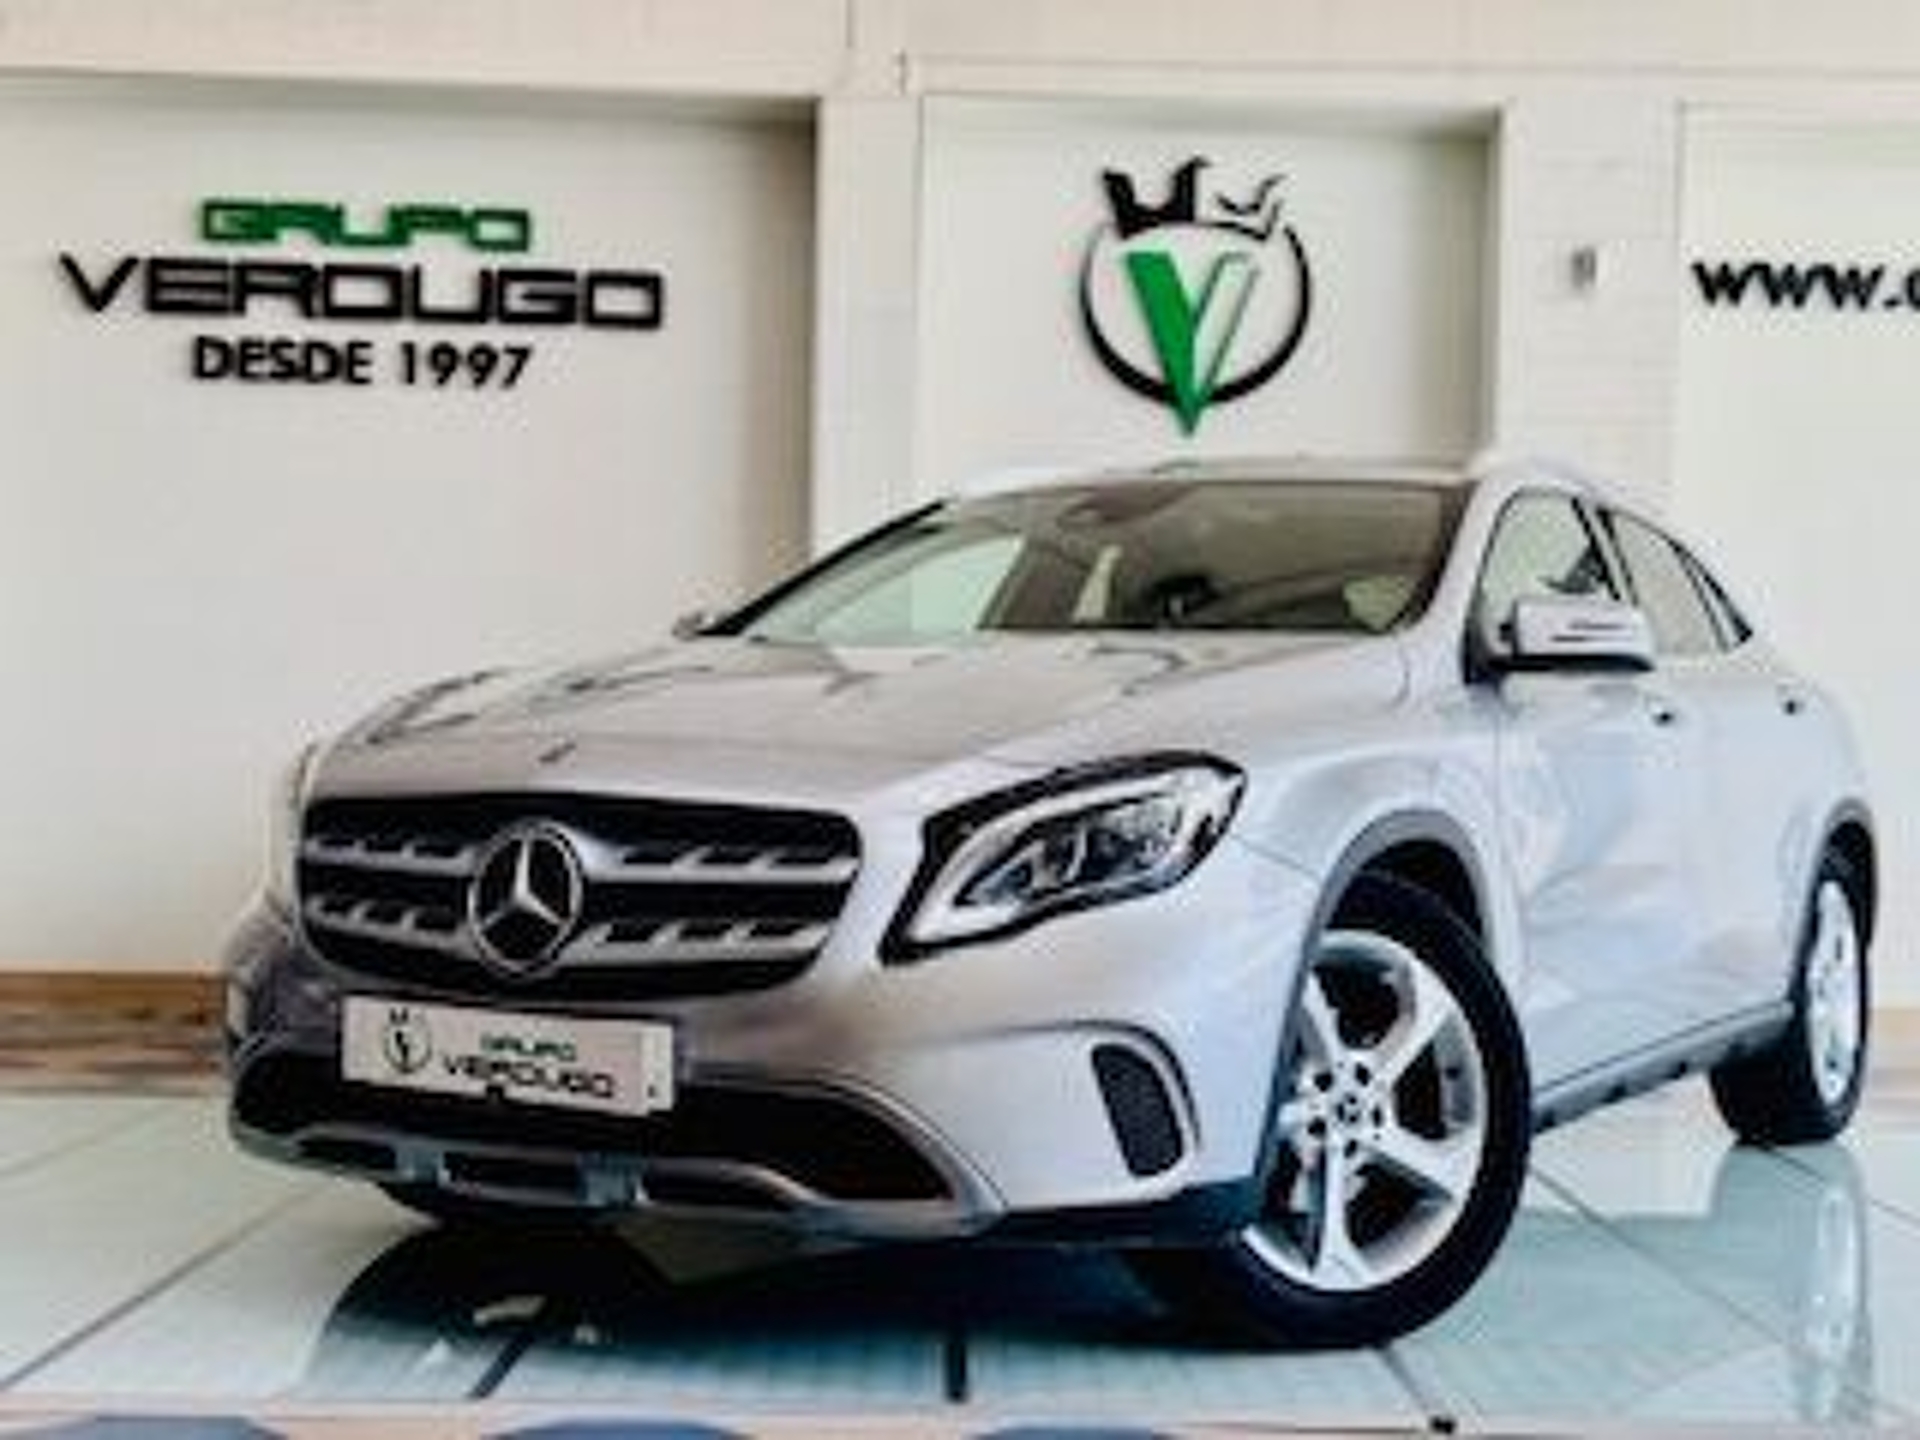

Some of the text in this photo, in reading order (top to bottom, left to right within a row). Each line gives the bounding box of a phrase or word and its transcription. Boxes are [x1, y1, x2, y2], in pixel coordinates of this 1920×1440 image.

[200, 199, 531, 252] GRUPO
[59, 253, 664, 331] VERDUGO
[191, 335, 533, 389] DESDE 1997
